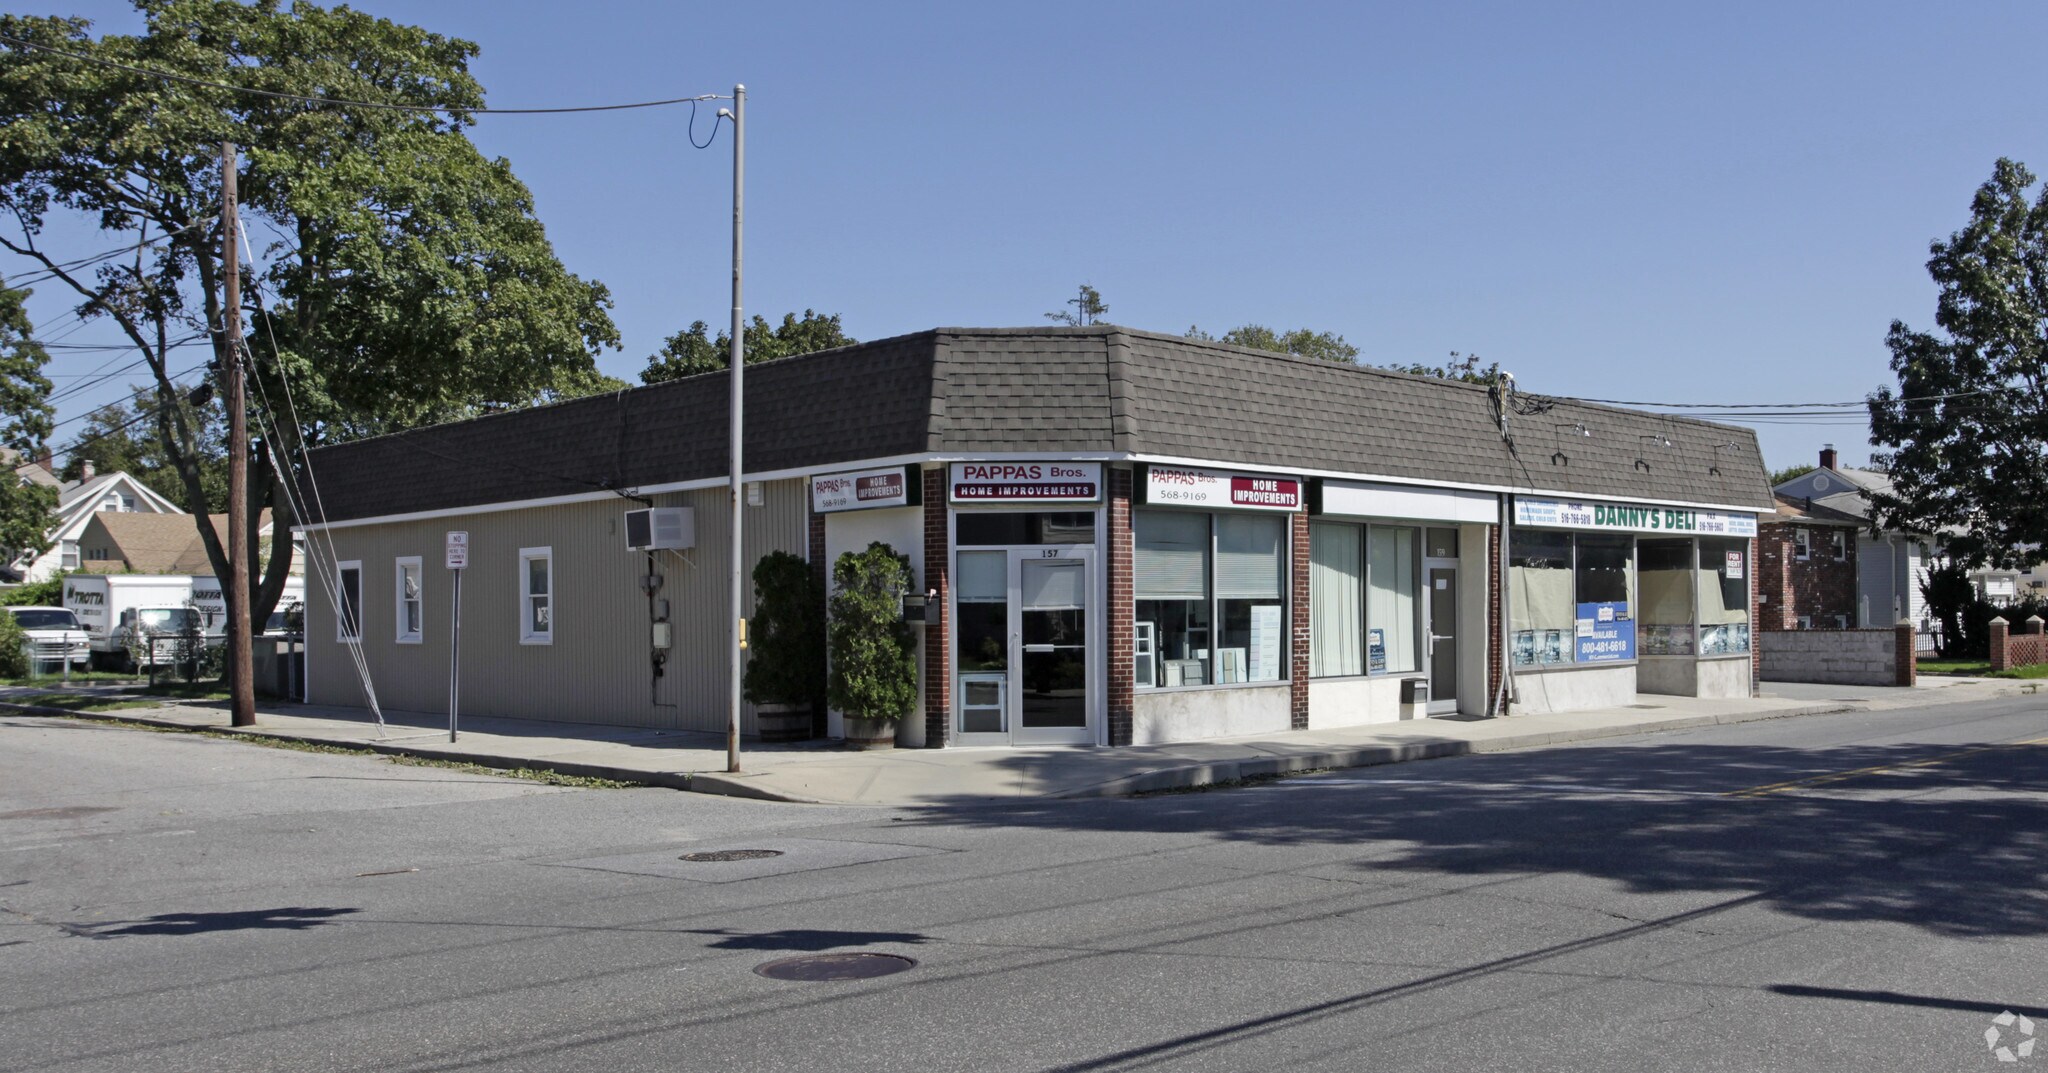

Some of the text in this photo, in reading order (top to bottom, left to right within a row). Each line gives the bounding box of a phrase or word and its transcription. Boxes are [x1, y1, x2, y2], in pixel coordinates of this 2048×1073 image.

[963, 465, 1087, 480] PAPPAS Bros.
[1152, 469, 1218, 485] PAPPAS Bros.
[815, 478, 851, 494] PAPPAS Bros.
[869, 476, 887, 486] HOME
[1252, 479, 1278, 492] HOME
[858, 485, 901, 498] IMPROVEMENTS
[961, 486, 1089, 496] HOME IMPROVEMENTS
[1160, 489, 1207, 501] 568-9169
[1233, 489, 1296, 505] IMPROVEMENTS
[822, 497, 847, 508] 568-9169
[1567, 502, 1583, 511] PHONE
[1594, 503, 1697, 531] DANNY'S DELI
[1042, 550, 1059, 558] 157
[1728, 552, 1740, 560] FOR
[74, 591, 104, 606] TROTTA
[1592, 630, 1618, 640] AVAILABLE
[1581, 640, 1627, 654] 800-481-6618
